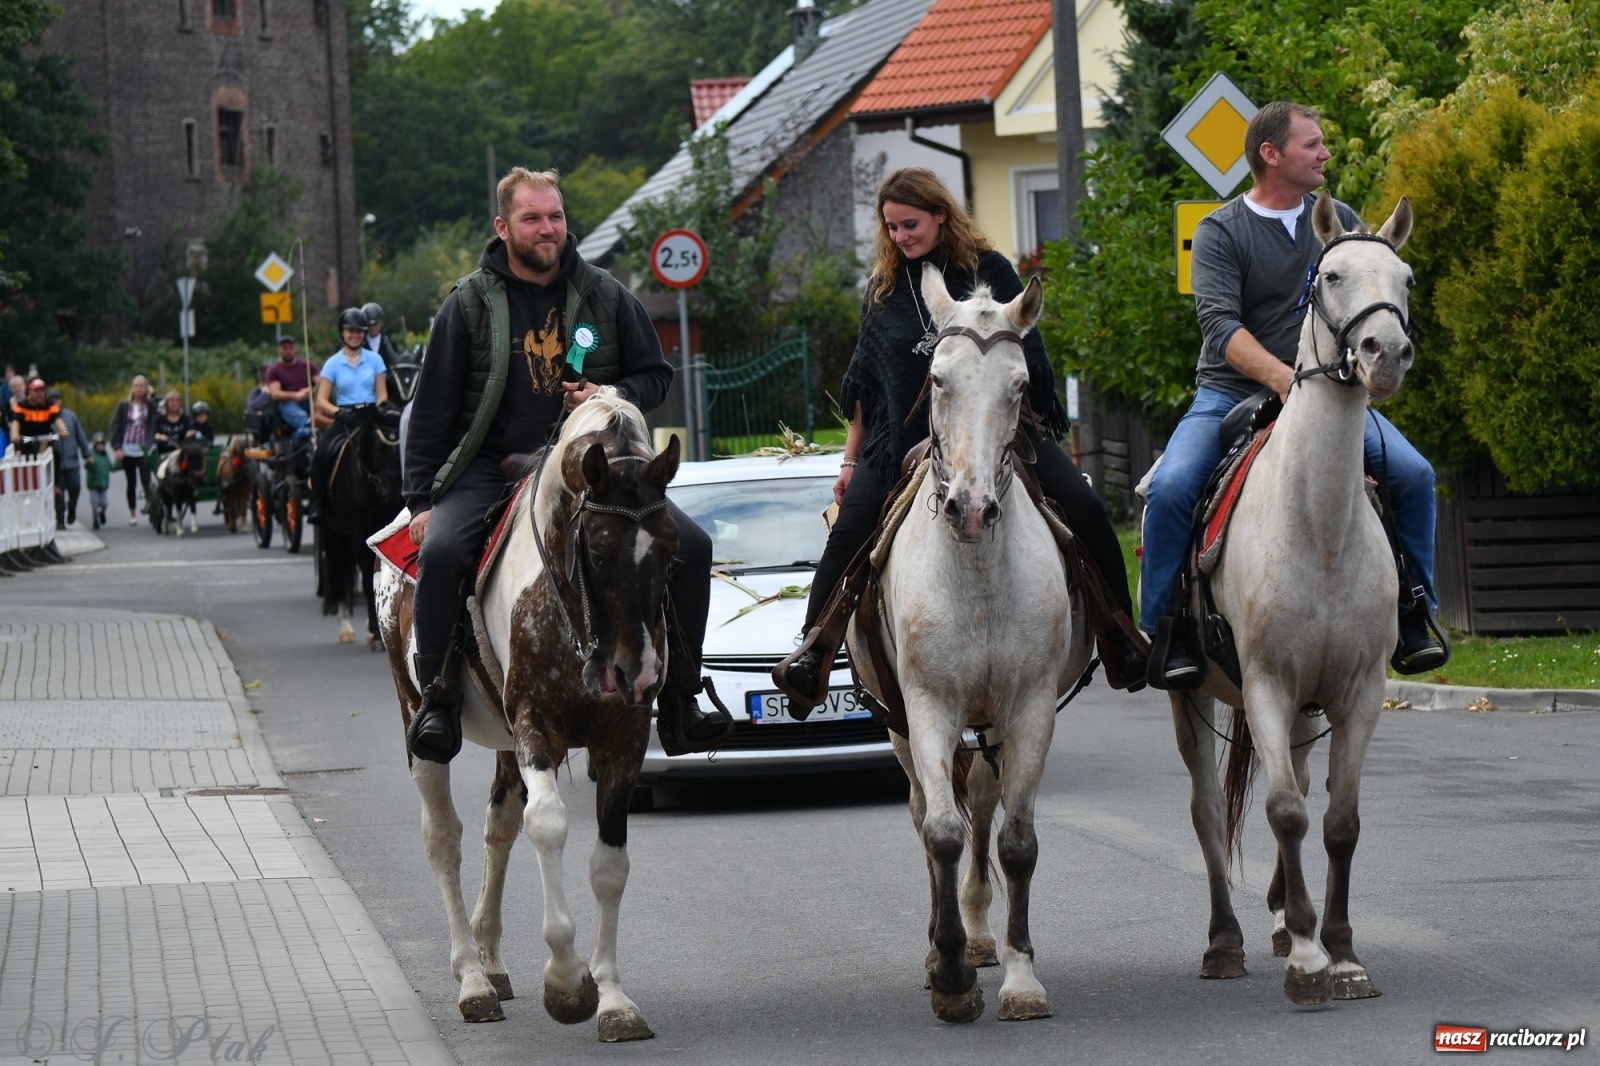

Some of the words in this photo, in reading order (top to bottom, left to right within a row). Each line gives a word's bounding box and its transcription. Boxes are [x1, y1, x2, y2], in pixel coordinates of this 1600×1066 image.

[660, 247, 698, 270] 2,5t
[766, 696, 791, 717] SR
[816, 691, 866, 714] VS
